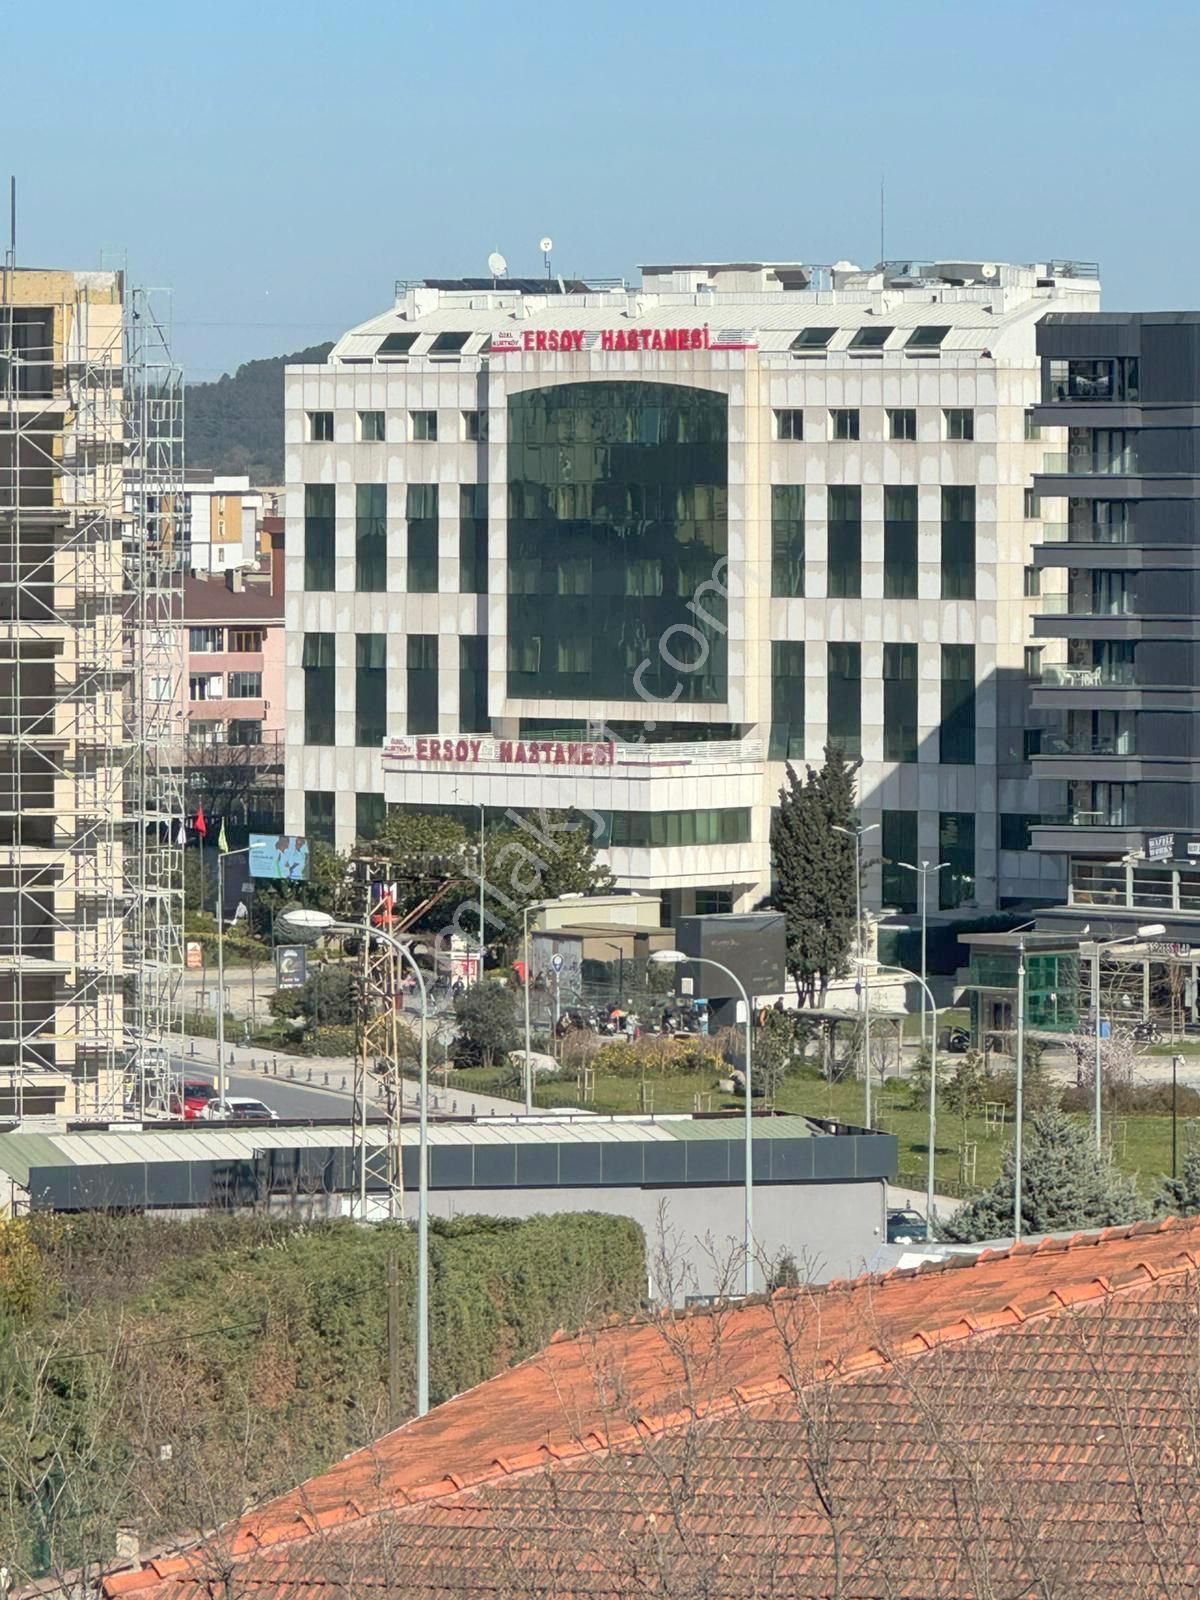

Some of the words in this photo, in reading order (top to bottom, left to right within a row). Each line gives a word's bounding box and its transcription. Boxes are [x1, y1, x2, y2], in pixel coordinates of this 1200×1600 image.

[522, 329, 585, 352] ERSOY
[600, 322, 710, 351] HASTANESİ
[416, 738, 482, 762] ERSOY
